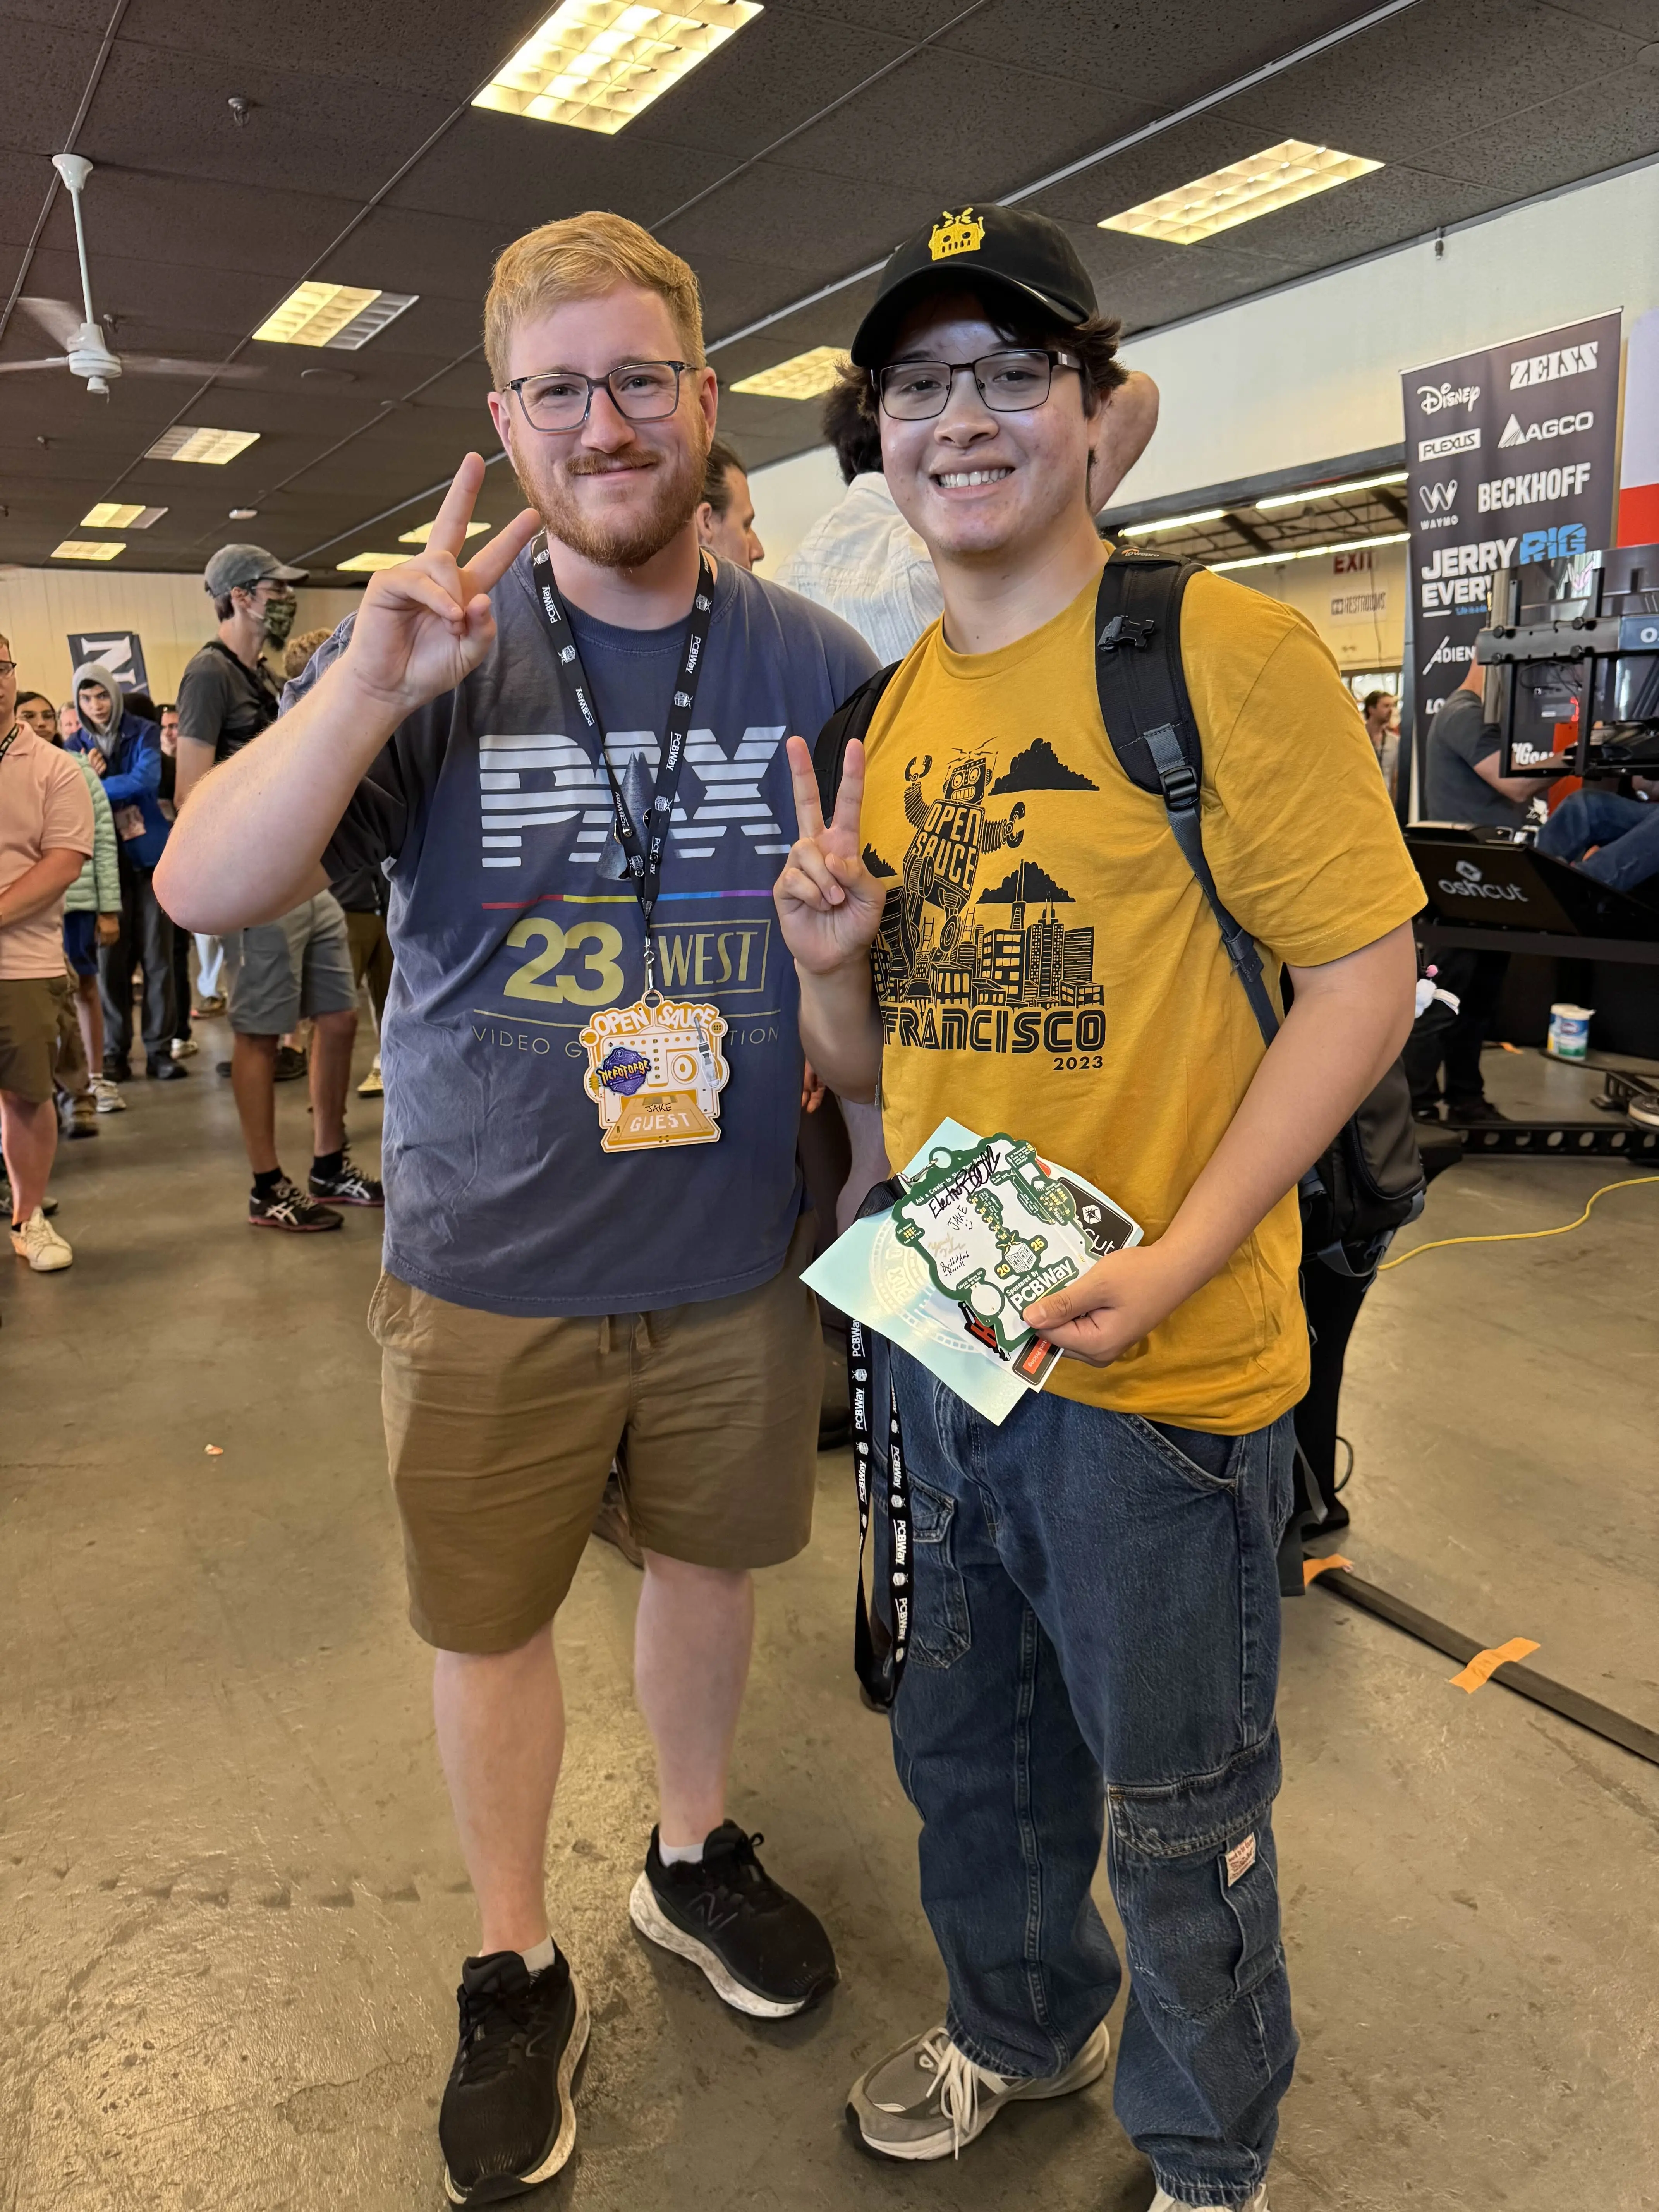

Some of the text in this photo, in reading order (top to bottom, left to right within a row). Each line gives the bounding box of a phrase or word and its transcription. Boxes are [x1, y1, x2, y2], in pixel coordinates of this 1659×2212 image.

[1510, 342, 1598, 390] ZEISS
[1422, 432, 1477, 458] PLEXUS
[1525, 411, 1594, 441] AGCO
[1478, 462, 1590, 513] BECKHOFF
[1420, 515, 1458, 530] WAYMO
[1333, 550, 1374, 574] EXIT
[542, 585, 560, 623] PCBWay
[685, 634, 701, 674] PCBWay
[575, 686, 594, 726] PCBWay
[667, 732, 682, 771] PCBWay
[479, 726, 791, 867] PAX
[924, 804, 981, 846] OPEN
[650, 836, 661, 874] PCay
[916, 833, 975, 890] SAUCE
[1438, 879, 1529, 902] oshcut
[504, 918, 758, 1006] 23 WEST
[594, 1005, 716, 1036] OPEN SAUCE
[882, 1006, 1106, 1053] FRANCISCO
[473, 1026, 550, 1054] VIDEO
[1053, 1056, 1103, 1070] 2023
[630, 1113, 690, 1132] GUEST
[645, 1103, 672, 1112] JAKE
[915, 1196, 924, 1204] Ask
[948, 1205, 967, 1230] JAKE
[1031, 1238, 1044, 1252] 25
[997, 1264, 1010, 1277] 20
[1006, 1275, 1031, 1296] Sponsored
[1010, 1260, 1073, 1311] PCBWay
[1028, 1340, 1048, 1367] tant Pricing
[855, 1388, 865, 1430] PCBWay
[893, 1446, 901, 1488] PCBWay
[896, 1520, 906, 1565] PCBWay
[898, 1597, 907, 1640] PCBWay
